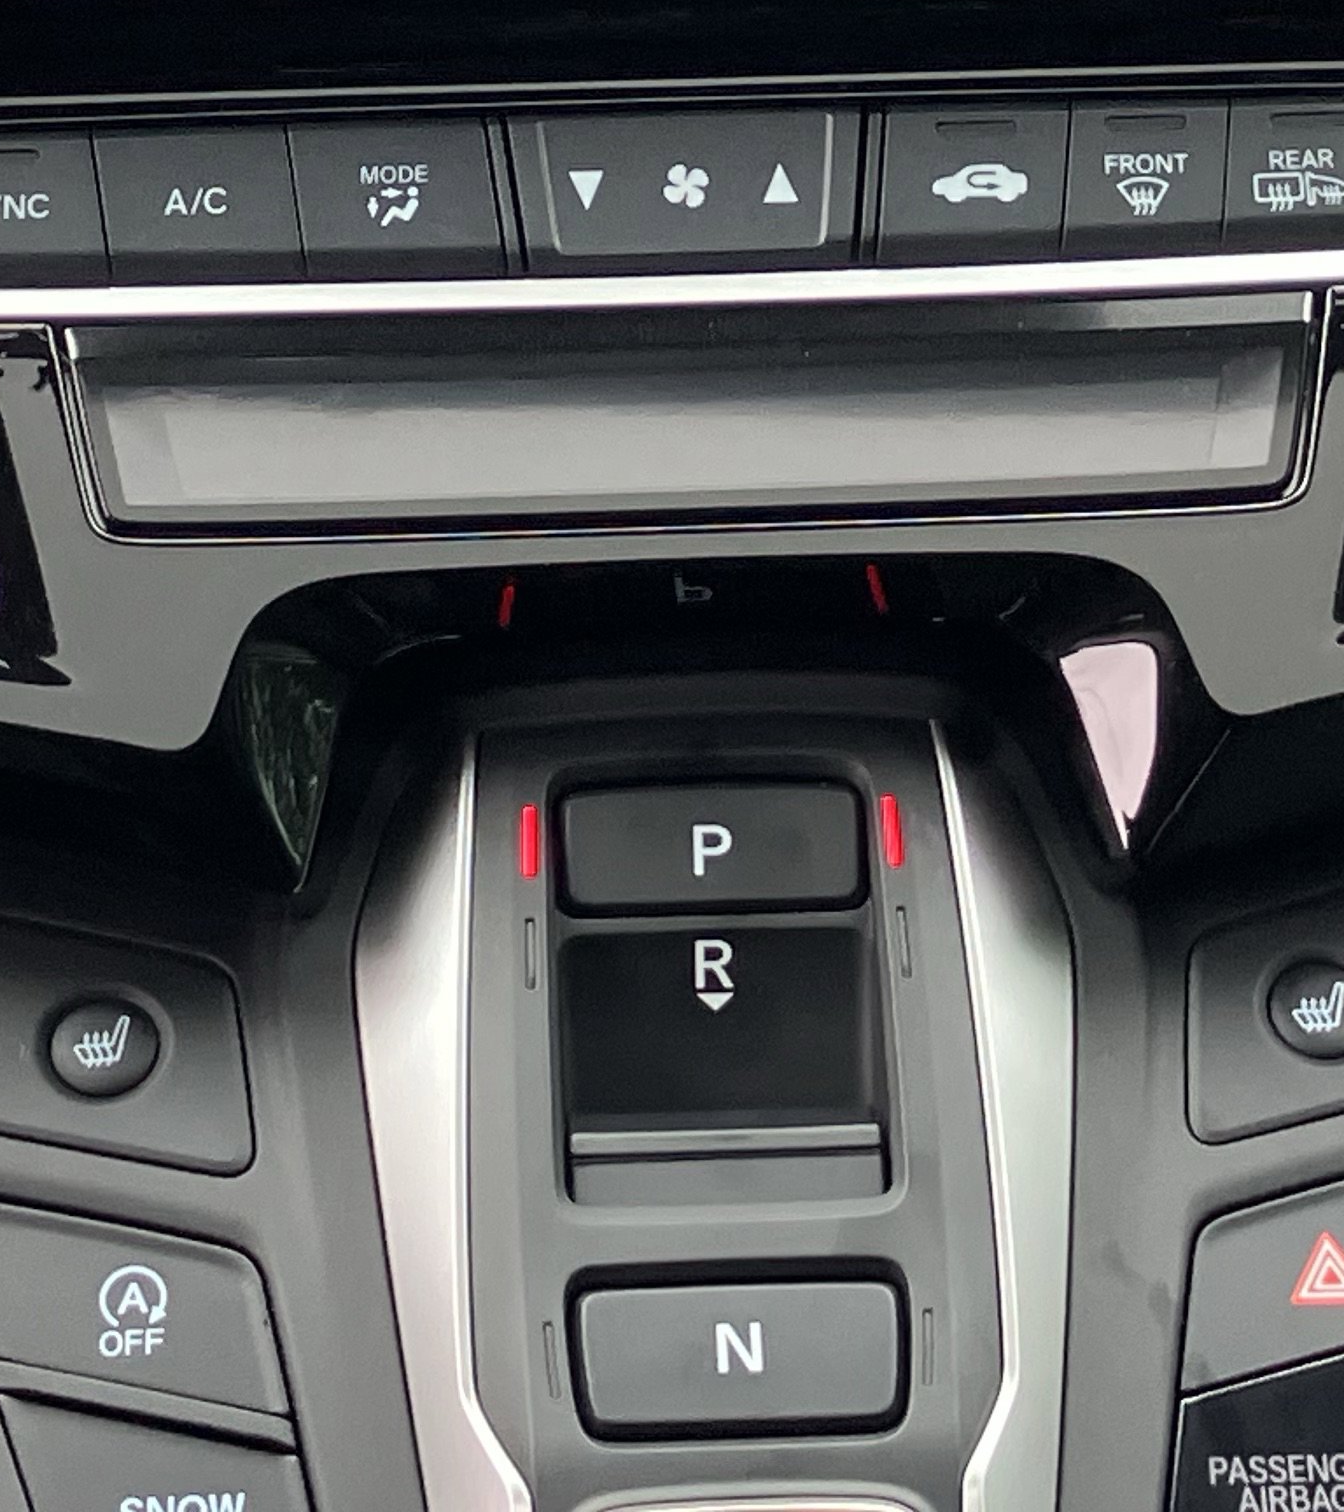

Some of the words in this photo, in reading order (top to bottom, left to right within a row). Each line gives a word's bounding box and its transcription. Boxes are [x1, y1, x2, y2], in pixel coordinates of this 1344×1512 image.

[1103, 153, 1189, 175] FRONT
[1268, 148, 1335, 170] REAR
[360, 164, 429, 185] MODE
[164, 186, 227, 216] A/C
[692, 824, 733, 877] P
[694, 939, 735, 990] R
[98, 1327, 165, 1358] OFF
[715, 1321, 764, 1374] N
